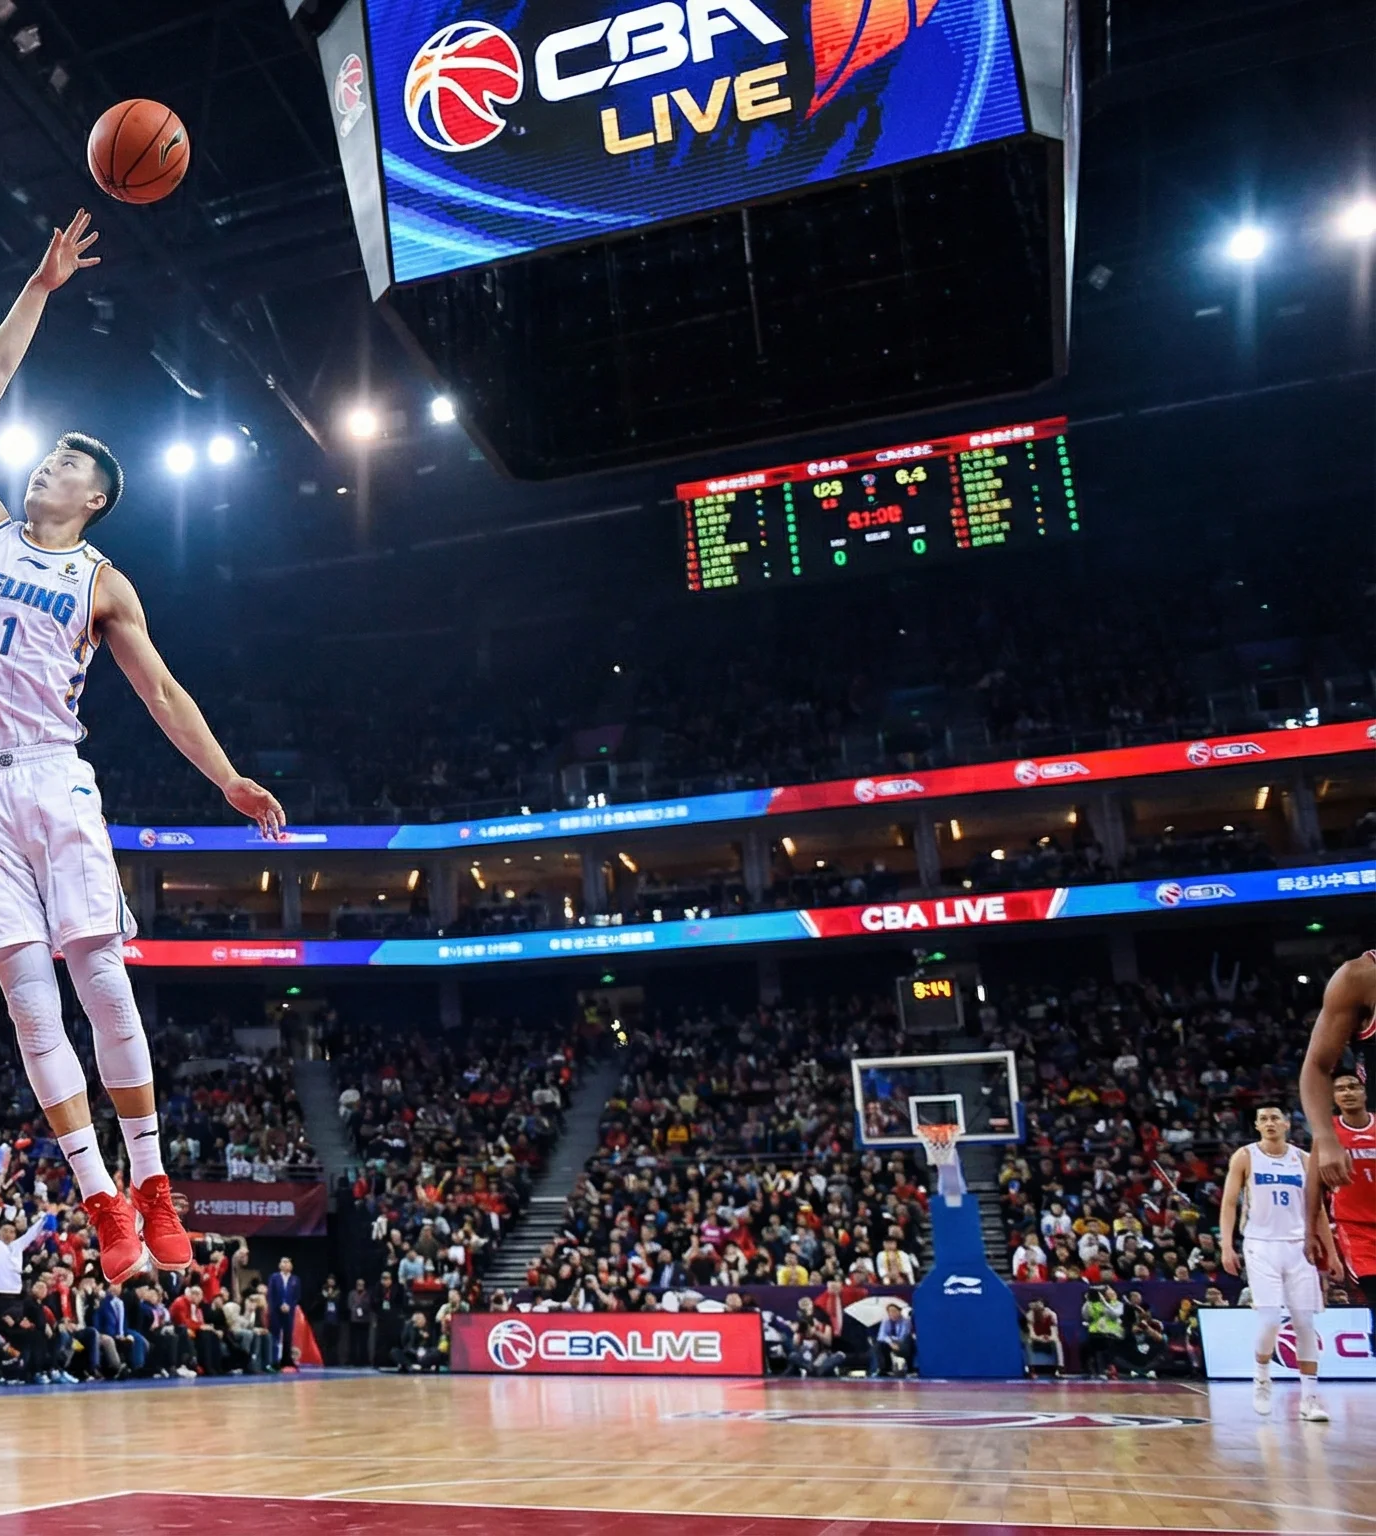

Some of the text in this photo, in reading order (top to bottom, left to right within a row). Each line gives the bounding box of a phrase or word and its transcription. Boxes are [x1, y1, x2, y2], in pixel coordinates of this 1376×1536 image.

[535, 0, 789, 101] CBA
[601, 61, 792, 154] LIVE
[0, 617, 17, 656] 1
[861, 896, 1007, 931] CBA LIVE
[540, 1333, 720, 1360] CBA LIVE
